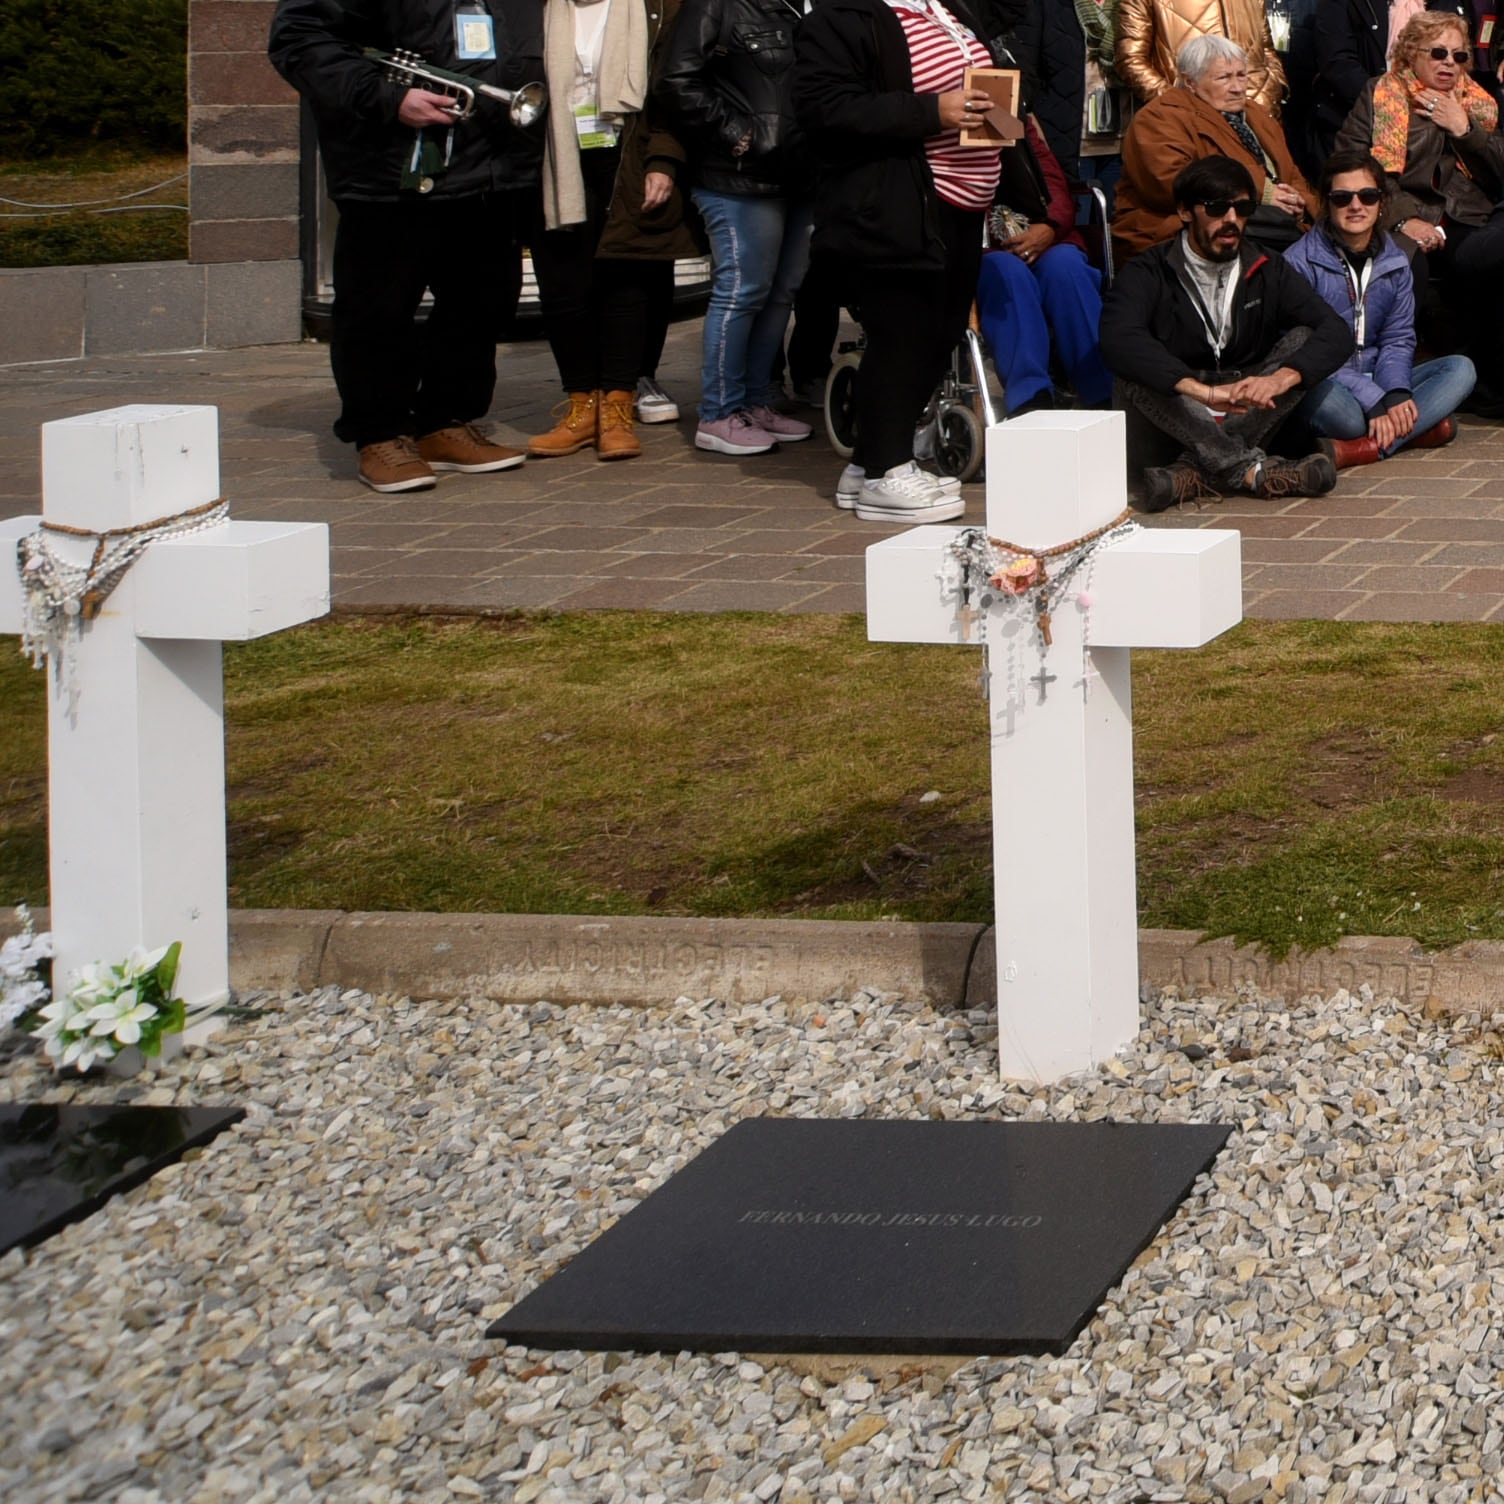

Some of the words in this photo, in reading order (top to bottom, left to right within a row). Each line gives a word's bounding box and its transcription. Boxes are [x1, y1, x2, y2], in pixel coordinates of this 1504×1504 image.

[737, 1210, 882, 1226] FERNANDO
[881, 1212, 965, 1228] JESUS
[965, 1214, 1043, 1228] LUGO
